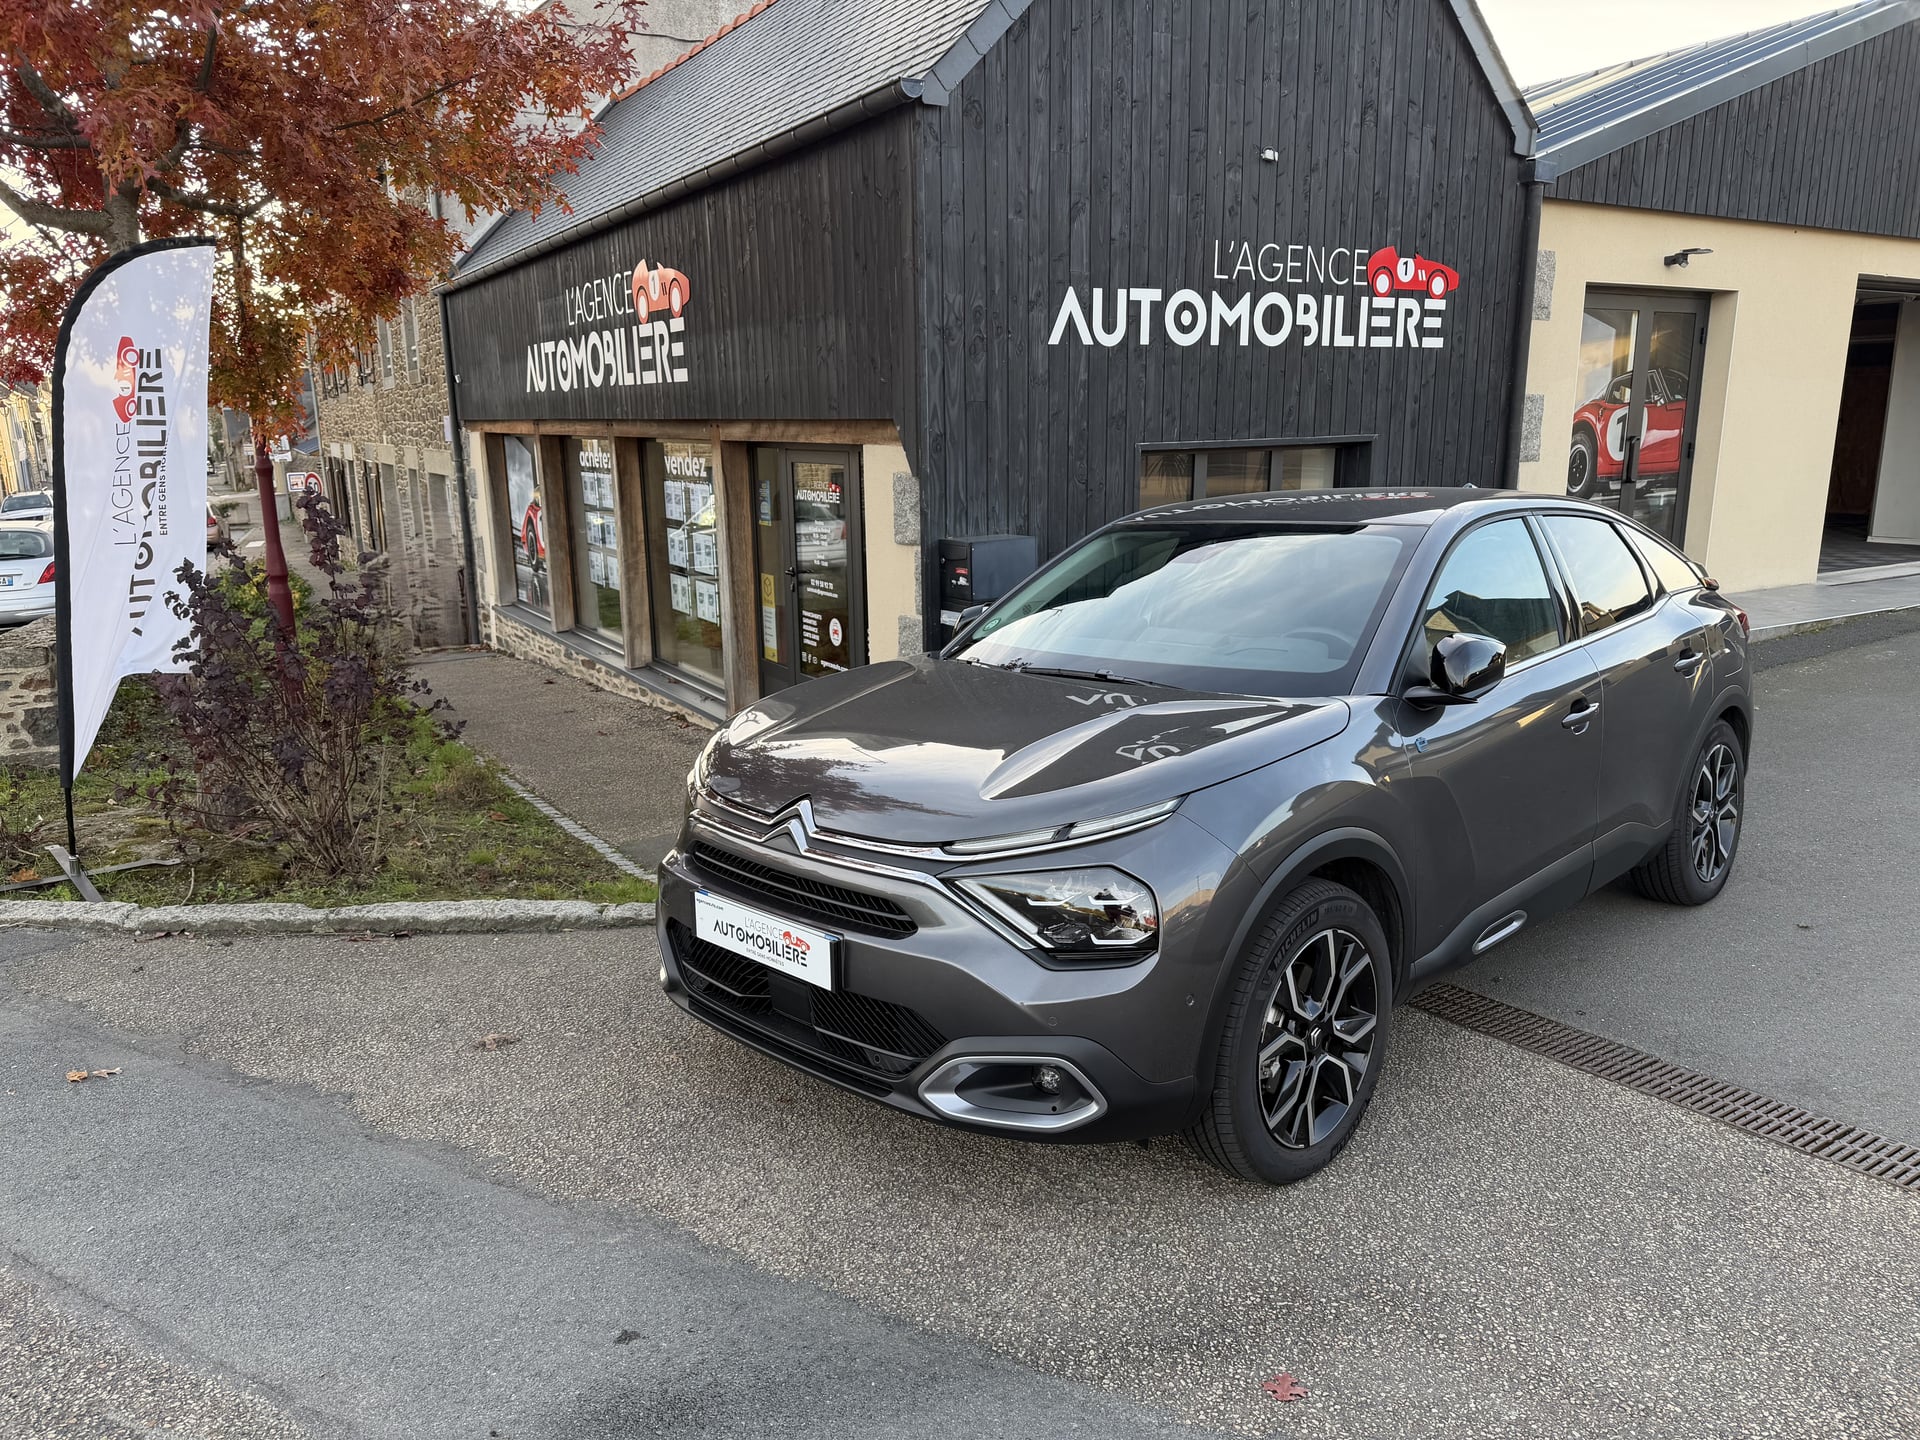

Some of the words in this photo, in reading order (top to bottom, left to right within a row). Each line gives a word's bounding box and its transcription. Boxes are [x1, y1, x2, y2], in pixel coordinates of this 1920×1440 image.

[1213, 239, 1369, 286] L'AGENCE
[565, 271, 634, 326] L'AGENCE
[112, 422, 137, 546] L'AGENCE
[664, 446, 707, 477] vendez
[129, 348, 167, 637] UTOOBILIERE
[158, 474, 167, 502] GENS
[159, 504, 168, 536] ENTRE
[744, 917, 783, 941] L'AGENCE
[1273, 911, 1318, 969] MICHELIN
